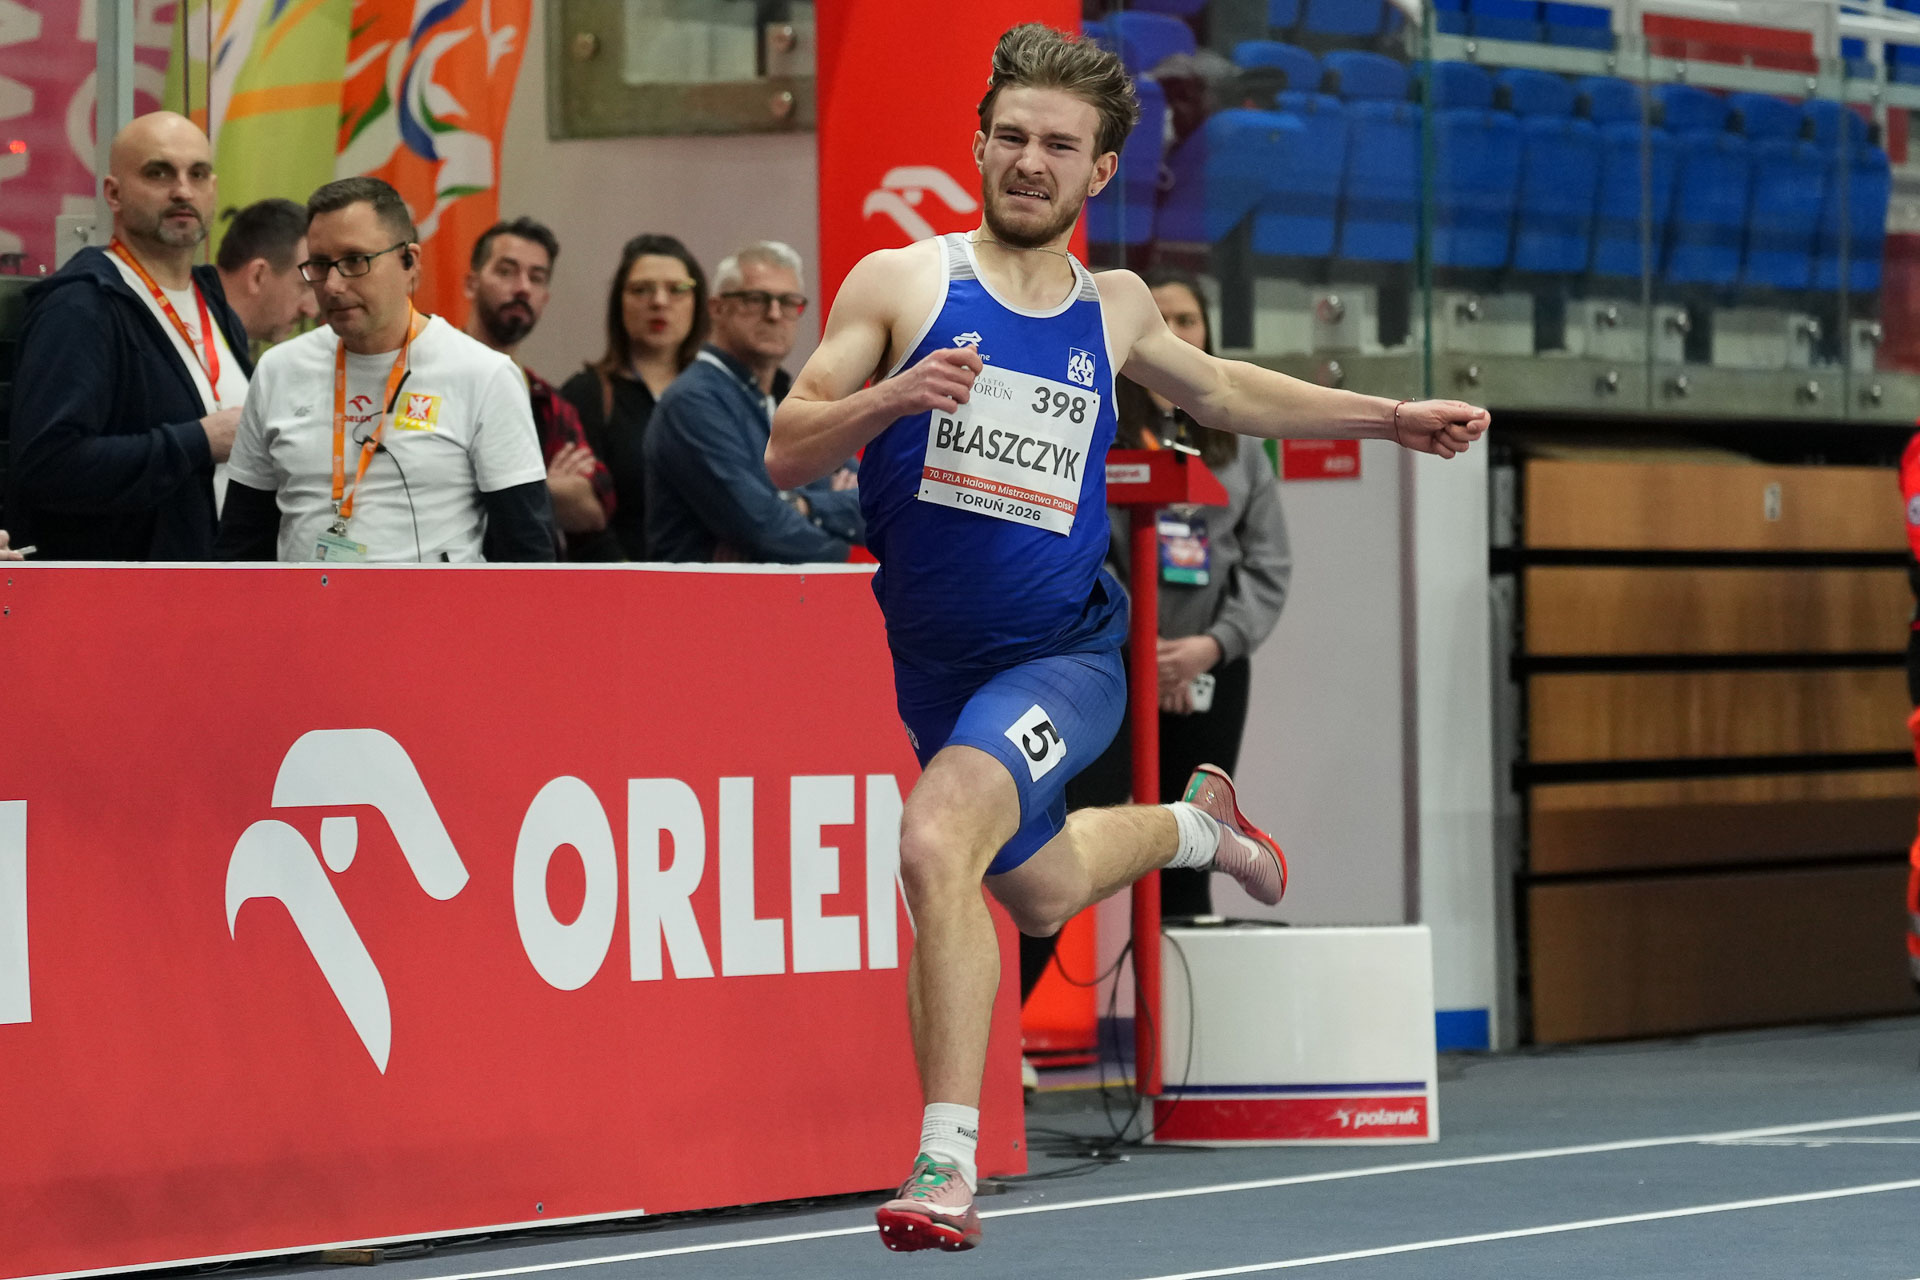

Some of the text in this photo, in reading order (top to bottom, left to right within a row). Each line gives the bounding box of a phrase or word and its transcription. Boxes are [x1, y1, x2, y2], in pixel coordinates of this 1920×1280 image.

[974, 382, 1014, 401] ORUŃ
[977, 375, 1005, 387] IASTO
[1031, 386, 1087, 424] 398
[935, 417, 1081, 482] BŁASZCZYK
[929, 469, 1075, 512] 70. PZLA Halowe Mistrzostwa Polski
[955, 491, 1041, 521] TORUŃ 2026
[1022, 720, 1061, 762] 5
[1353, 1107, 1419, 1130] polanik
